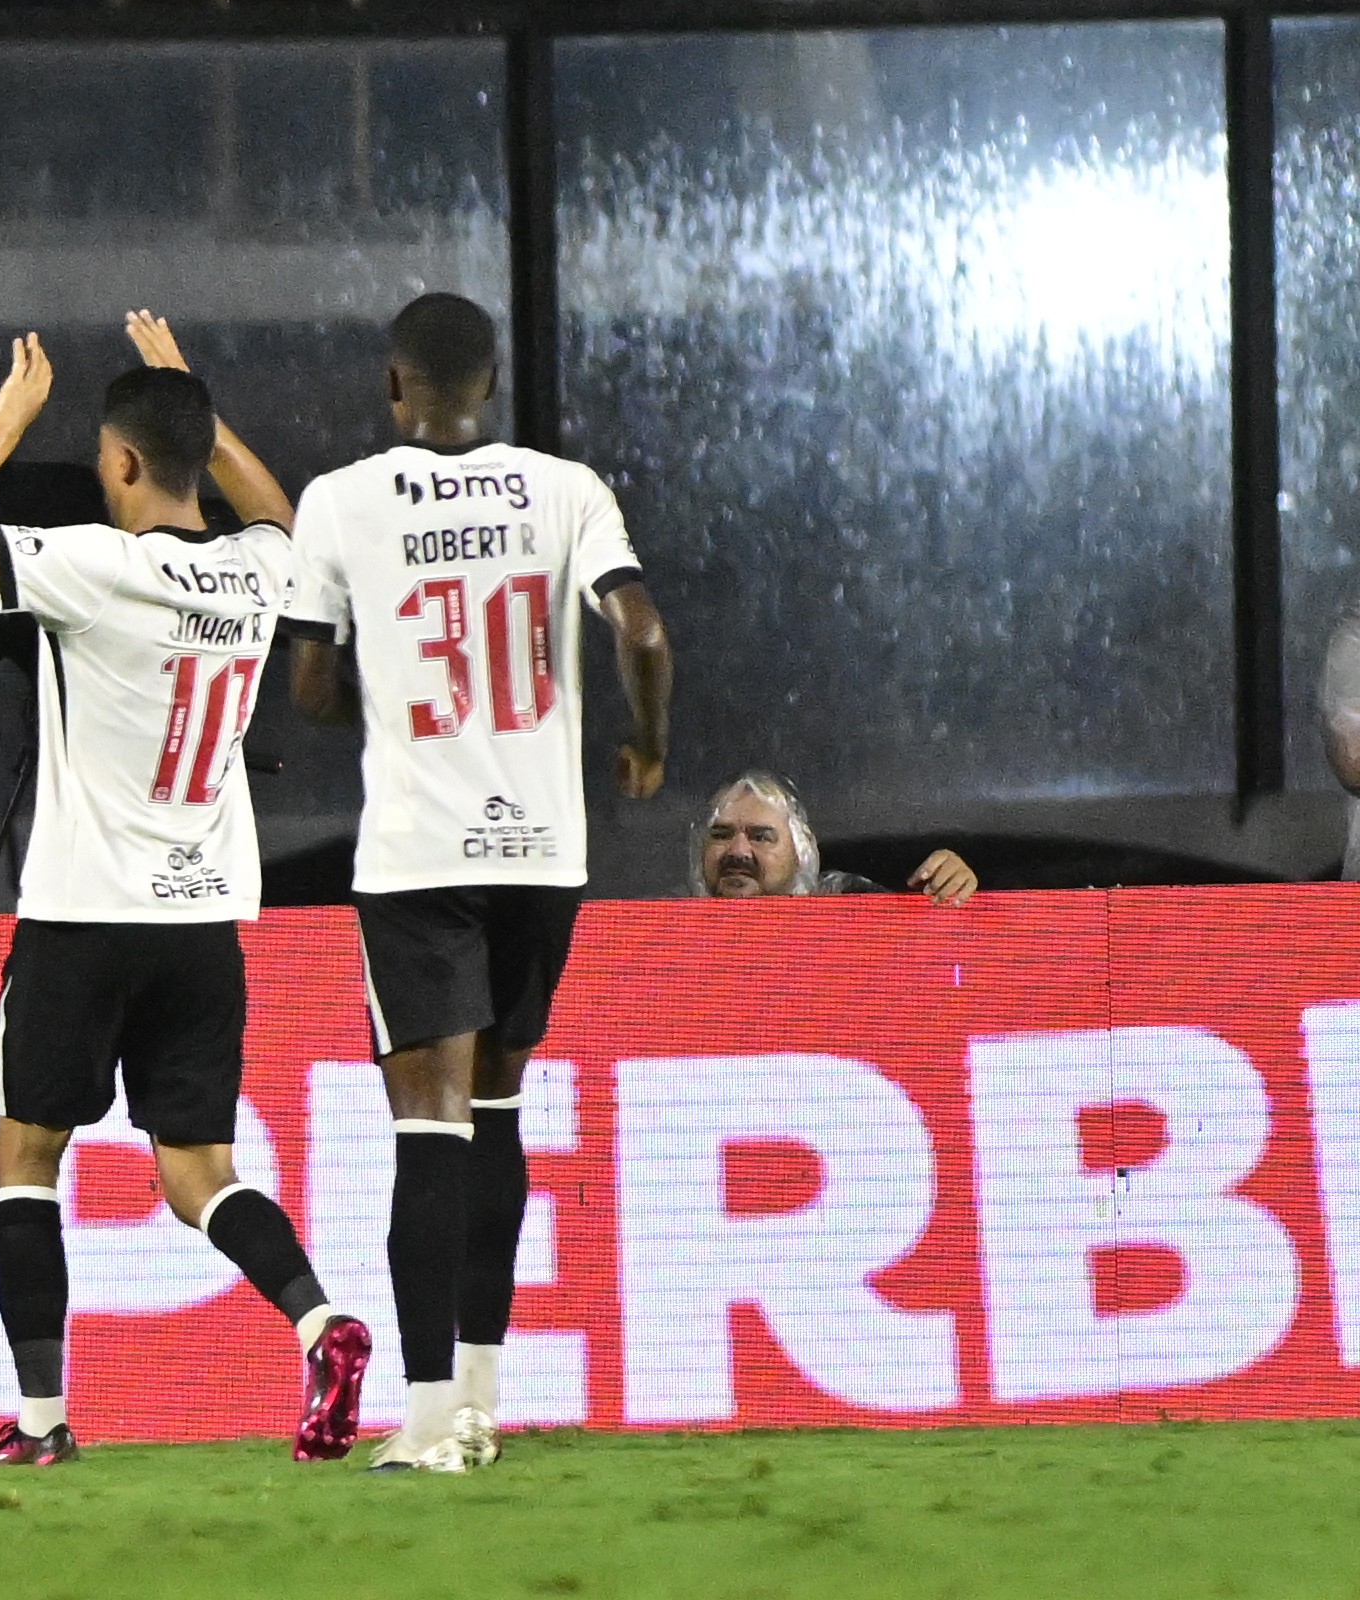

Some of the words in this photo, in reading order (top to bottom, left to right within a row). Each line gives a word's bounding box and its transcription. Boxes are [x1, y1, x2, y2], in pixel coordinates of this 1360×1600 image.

[431, 471, 532, 510] bmg
[402, 525, 510, 567] ROBERT
[190, 562, 267, 607] bmg
[168, 610, 244, 645] JOHAN
[395, 570, 560, 742] 30
[148, 652, 263, 806] 10
